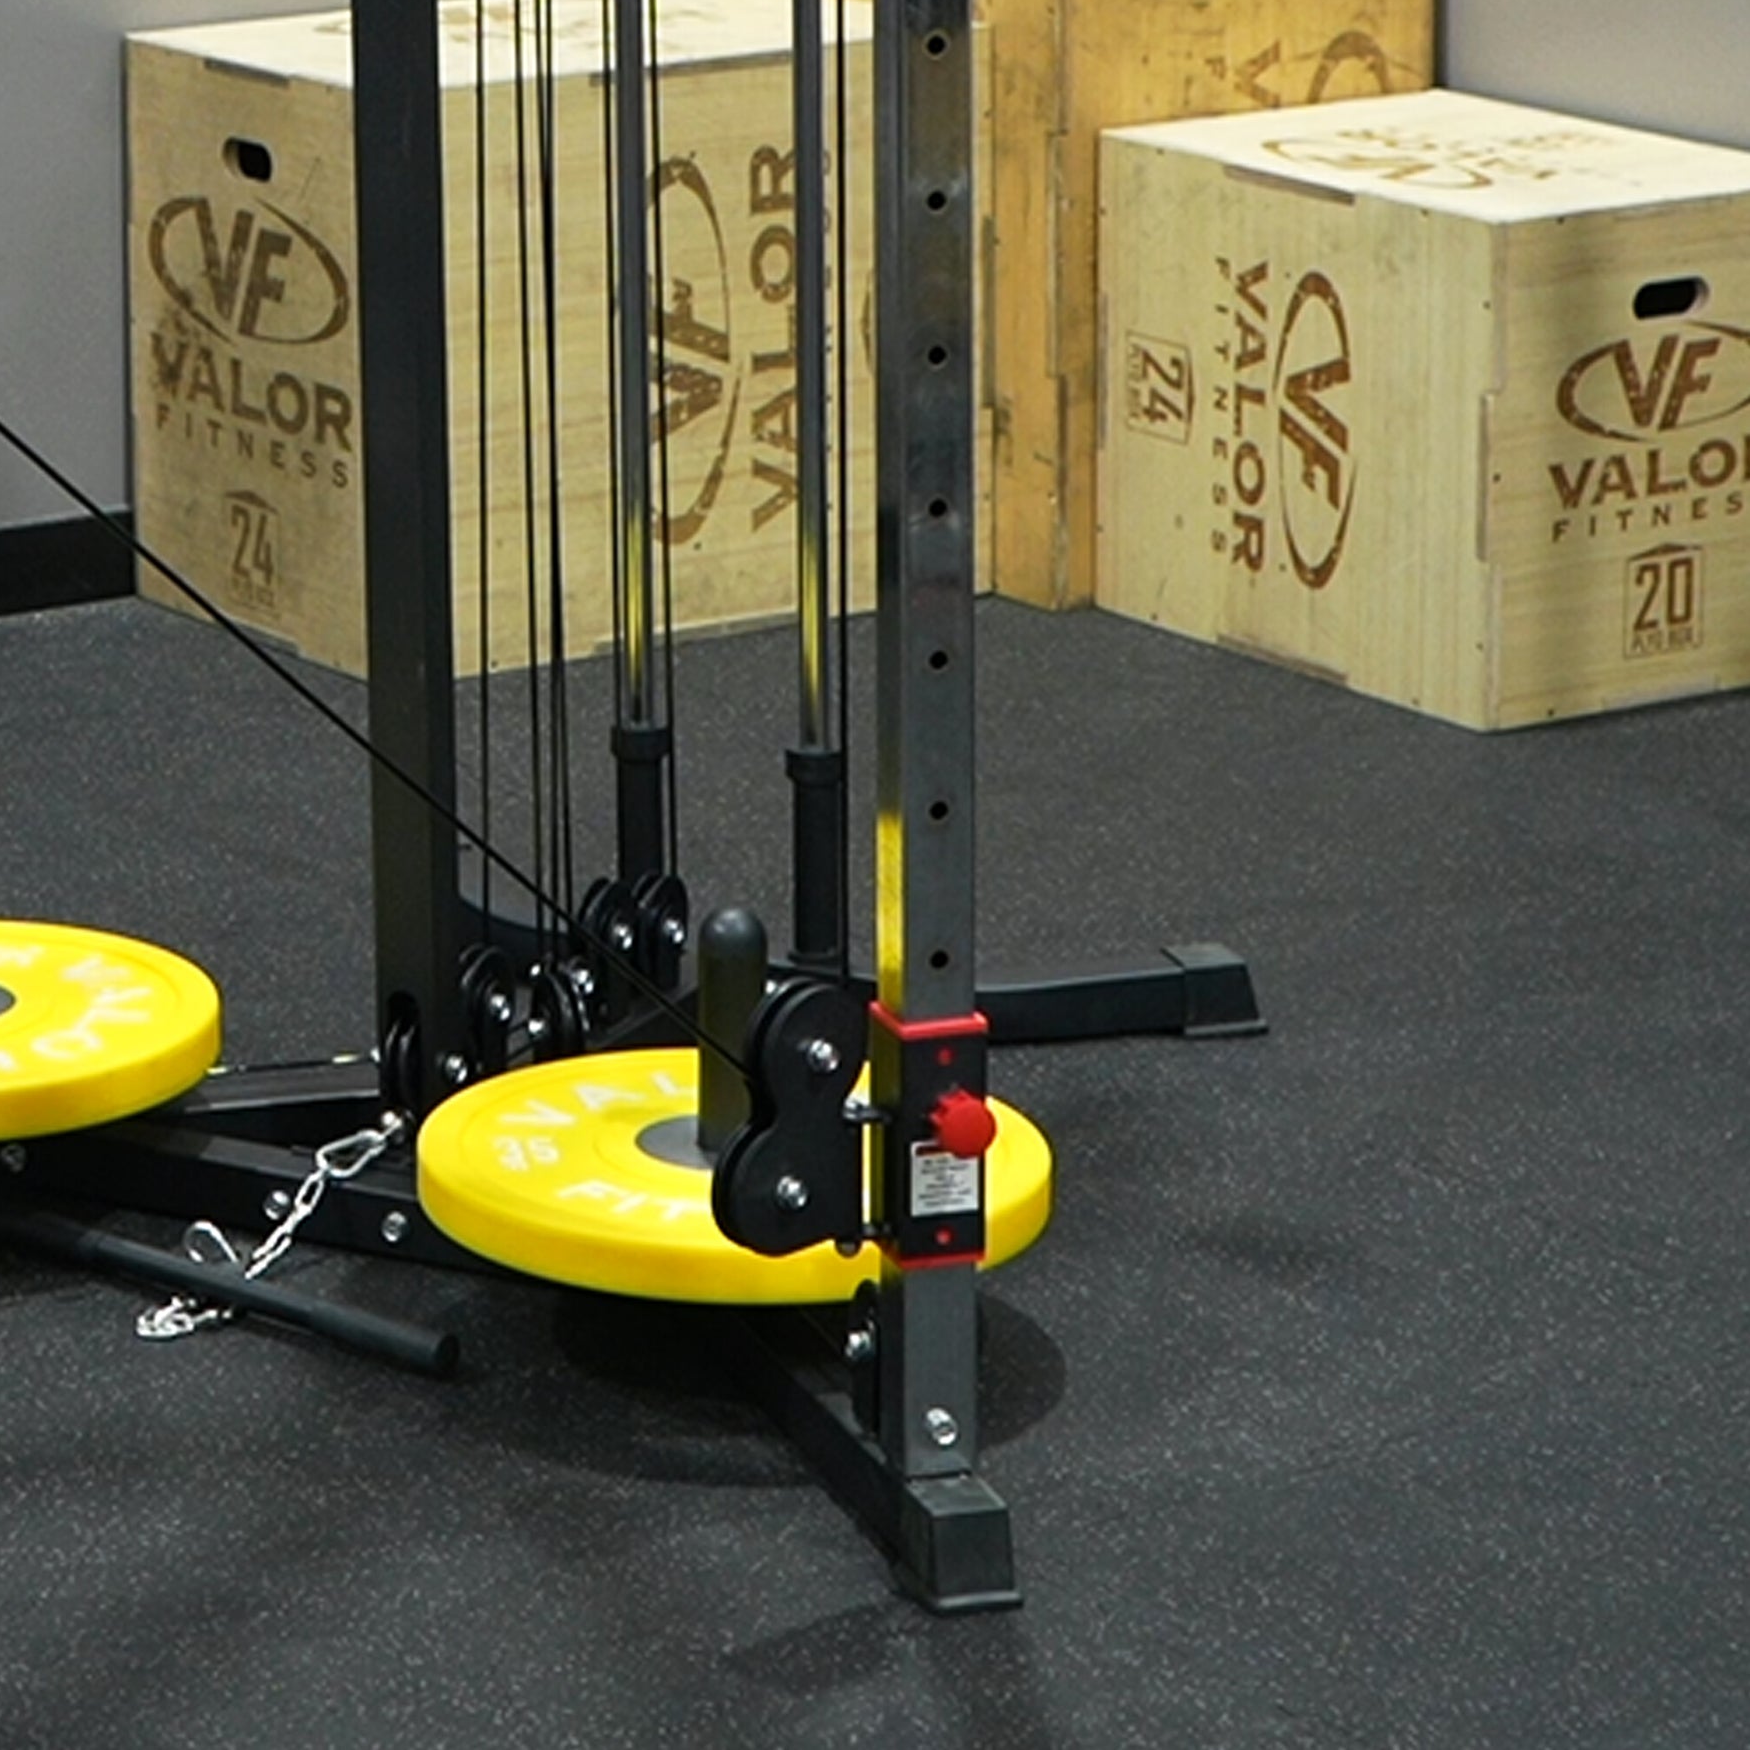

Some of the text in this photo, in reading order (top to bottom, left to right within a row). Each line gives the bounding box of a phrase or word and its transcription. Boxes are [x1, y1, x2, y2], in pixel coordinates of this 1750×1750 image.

[150, 330, 353, 454] VALOR
[1141, 349, 1185, 424] 24
[1211, 256, 1232, 556] FITNESS
[1232, 260, 1269, 573] VALOR
[1611, 332, 1723, 433] VF
[156, 401, 349, 490] FITNESS
[230, 503, 273, 587] 24
[1552, 489, 1746, 544] FITNES
[1634, 557, 1694, 631] 20
[497, 1071, 699, 1126] VAL
